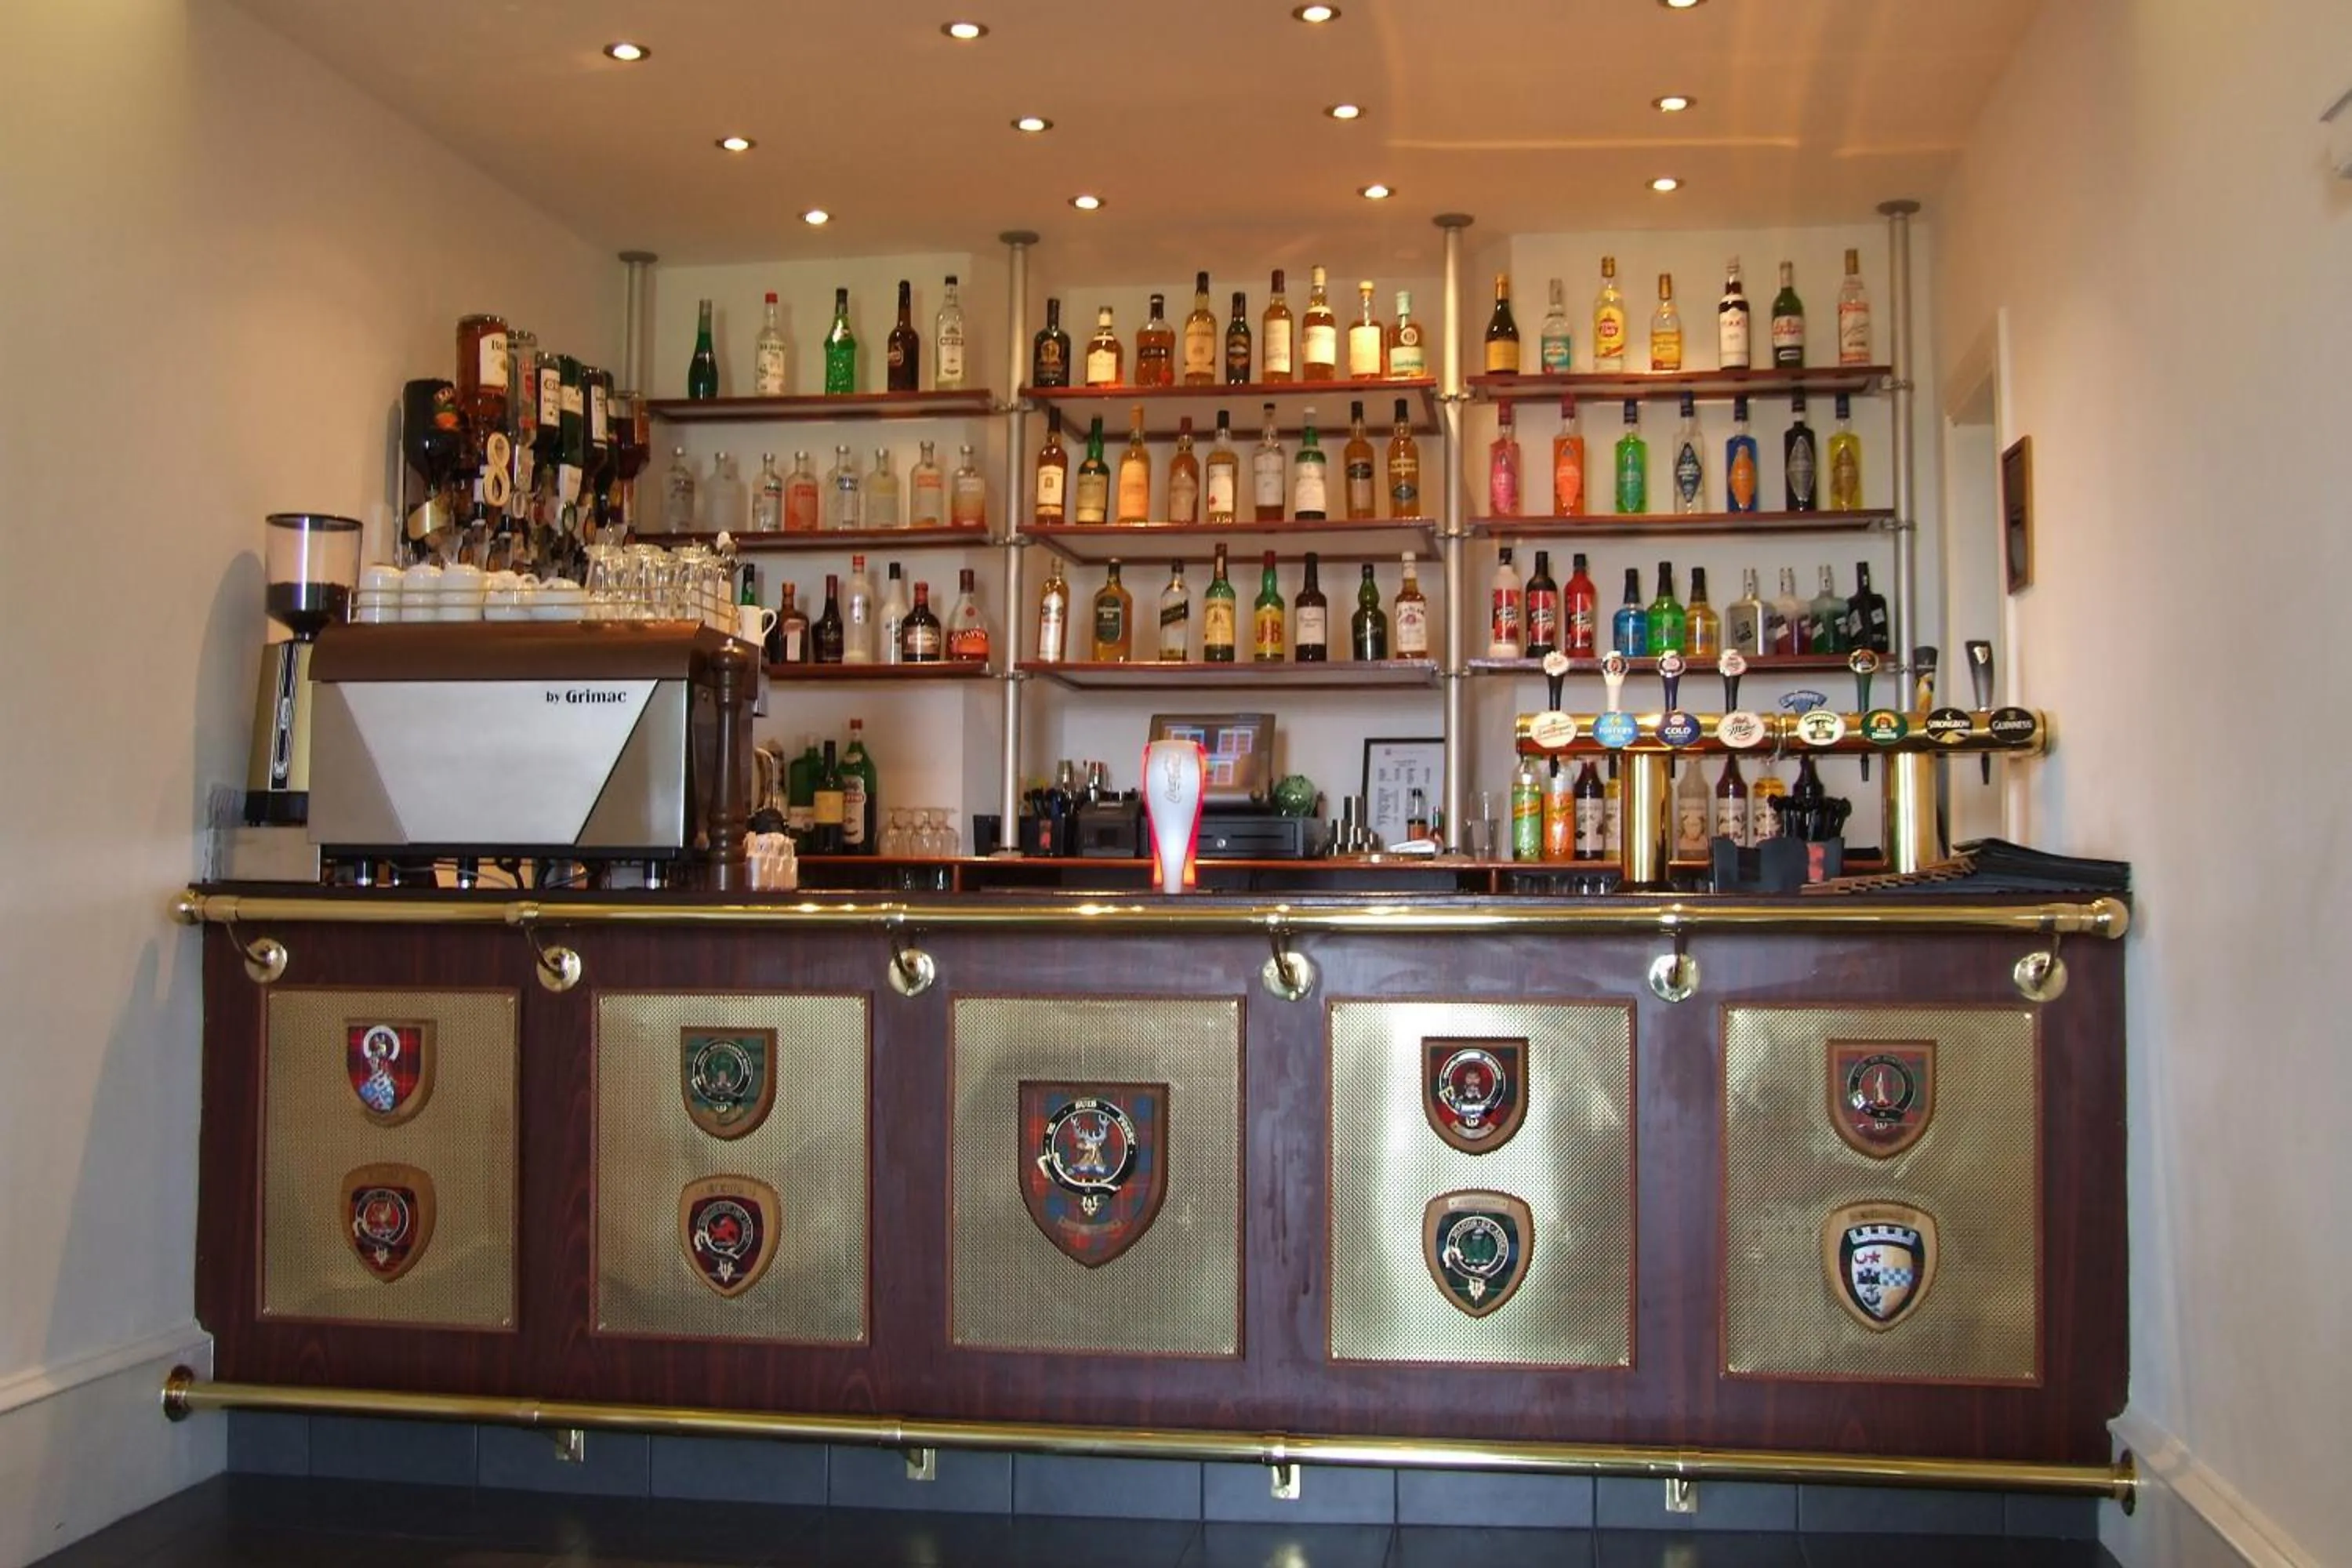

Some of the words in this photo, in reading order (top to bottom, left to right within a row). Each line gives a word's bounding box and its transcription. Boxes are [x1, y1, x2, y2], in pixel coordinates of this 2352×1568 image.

[546, 691, 560, 703] by
[565, 688, 627, 704] Grimac
[1664, 726, 1692, 735] COLD
[1991, 720, 2033, 731] GUINNESS
